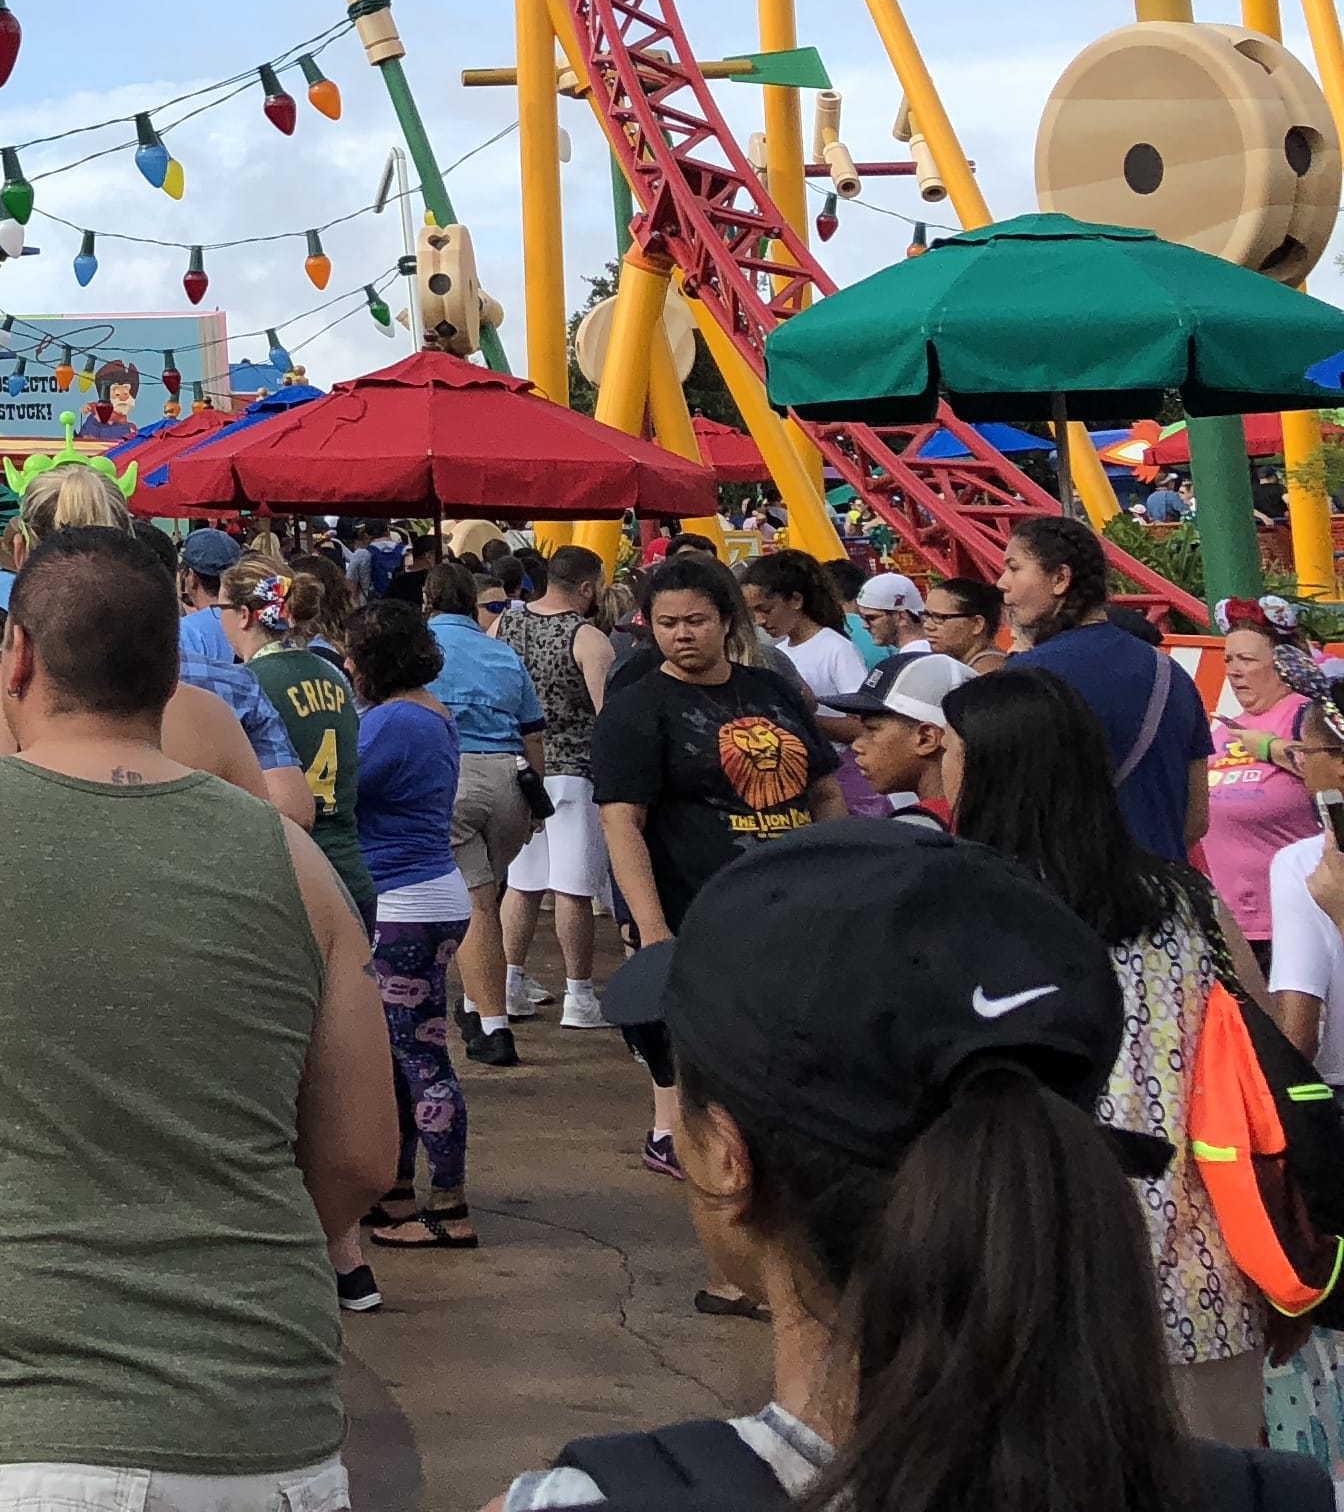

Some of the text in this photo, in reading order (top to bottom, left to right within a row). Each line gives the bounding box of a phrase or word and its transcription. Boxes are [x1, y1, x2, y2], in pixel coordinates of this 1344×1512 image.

[287, 679, 345, 718] CRISP
[305, 728, 338, 812] 4
[729, 814, 758, 829] THE
[756, 811, 791, 831] LION
